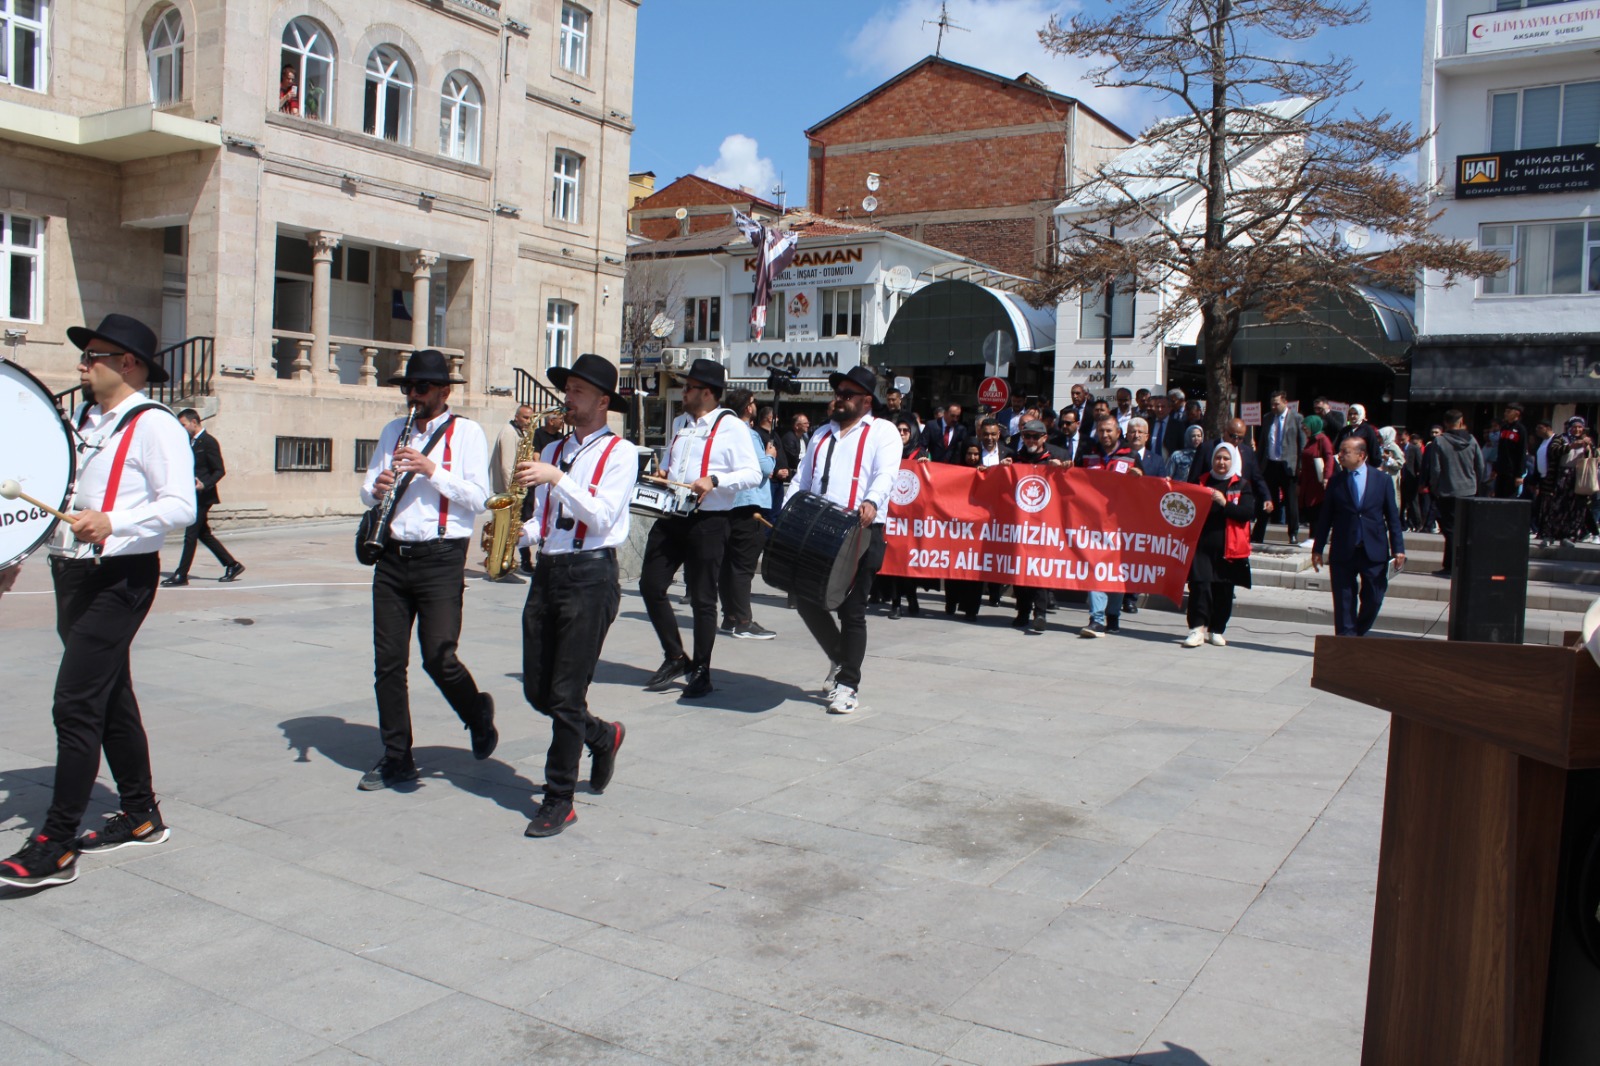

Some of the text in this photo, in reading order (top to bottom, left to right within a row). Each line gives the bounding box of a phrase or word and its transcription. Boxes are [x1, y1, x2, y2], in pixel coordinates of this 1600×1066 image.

[1493, 19, 1517, 33] İLİM
[1520, 15, 1558, 29] YAYMA
[1515, 153, 1585, 166] MİMARLIK
[1505, 163, 1595, 178] İÇ MİMARLIK
[796, 268, 818, 280] İNŞAAT
[823, 265, 854, 277] OTOMOTİV
[747, 352, 839, 368] KOCAMAN
[1089, 372, 1117, 382] DÖZ
[886, 517, 908, 536] EN
[913, 516, 974, 540] BÜYÜK
[908, 549, 950, 569] 2025
[954, 548, 993, 572] AİLE
[996, 554, 1021, 575] YILI
[1026, 557, 1089, 581] KUTLU
